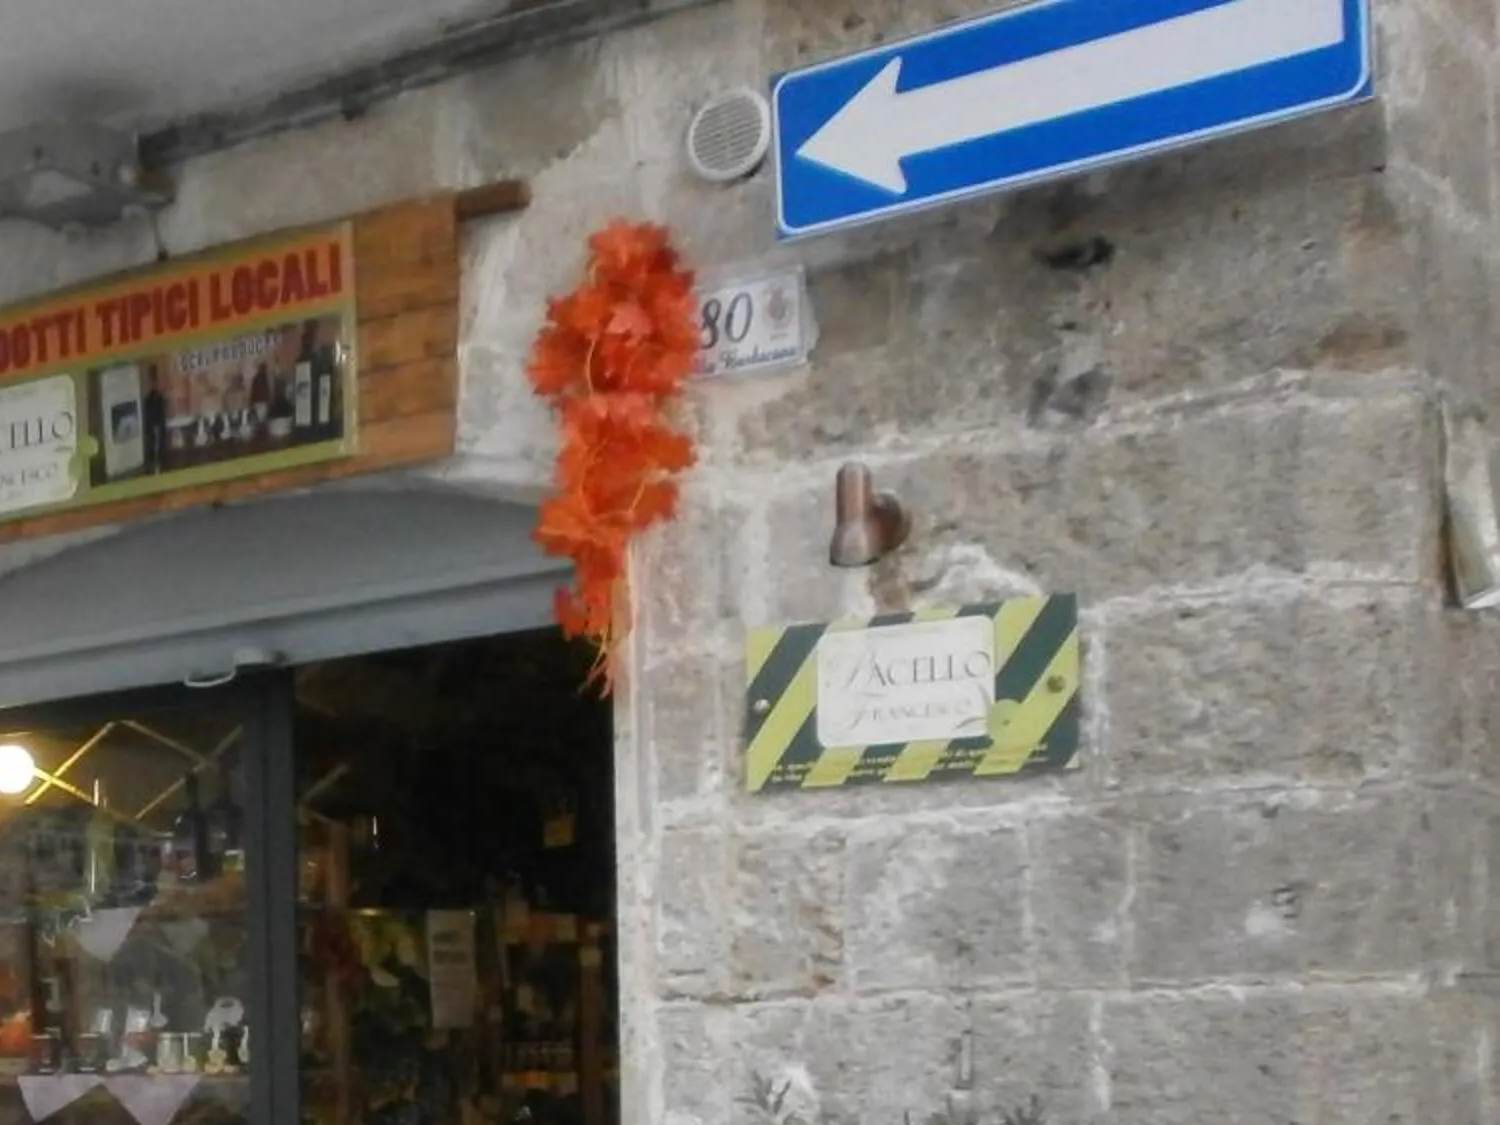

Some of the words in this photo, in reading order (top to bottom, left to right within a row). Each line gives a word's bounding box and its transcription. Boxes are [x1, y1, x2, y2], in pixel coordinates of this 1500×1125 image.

[97, 278, 199, 347] TIPICI
[211, 241, 343, 321] LOCALI
[700, 291, 753, 350] 80
